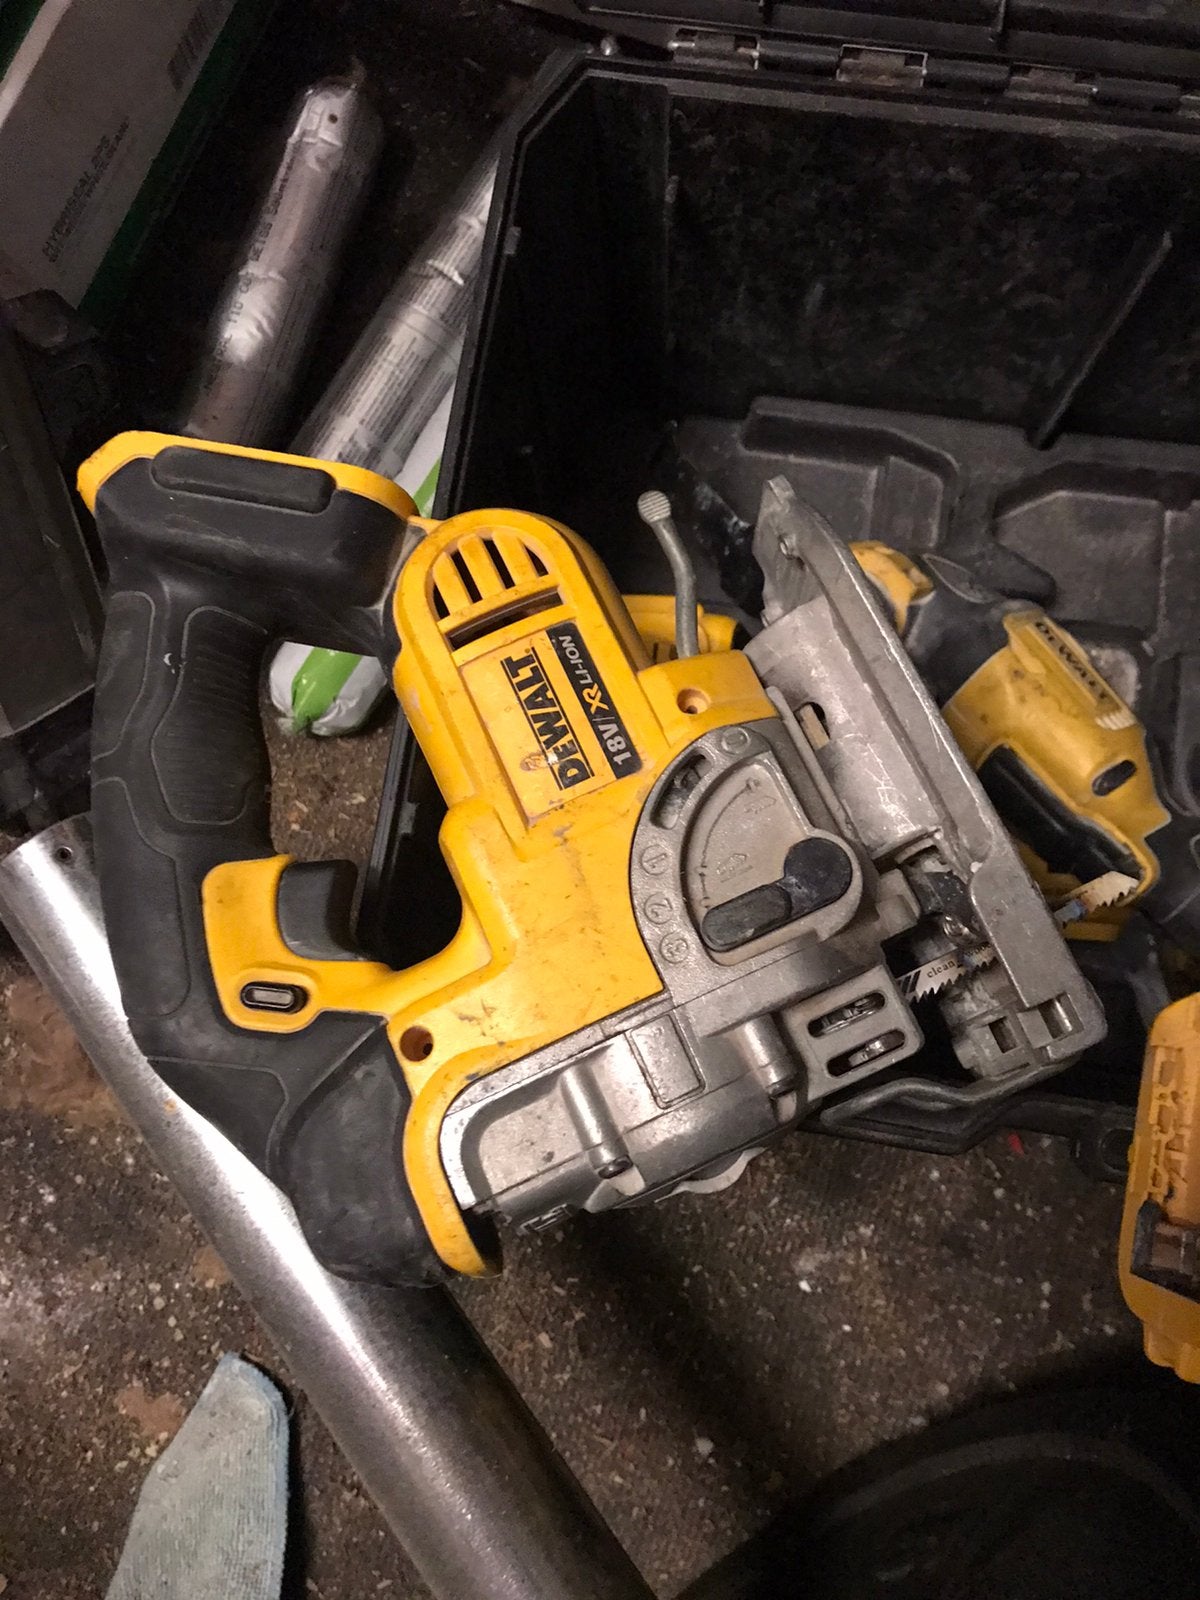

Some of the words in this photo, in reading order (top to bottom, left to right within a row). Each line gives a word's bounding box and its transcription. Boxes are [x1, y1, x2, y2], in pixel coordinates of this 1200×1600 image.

[559, 635, 593, 685] LI-ION
[504, 653, 591, 789] DEWALT
[926, 959, 957, 979] clean
